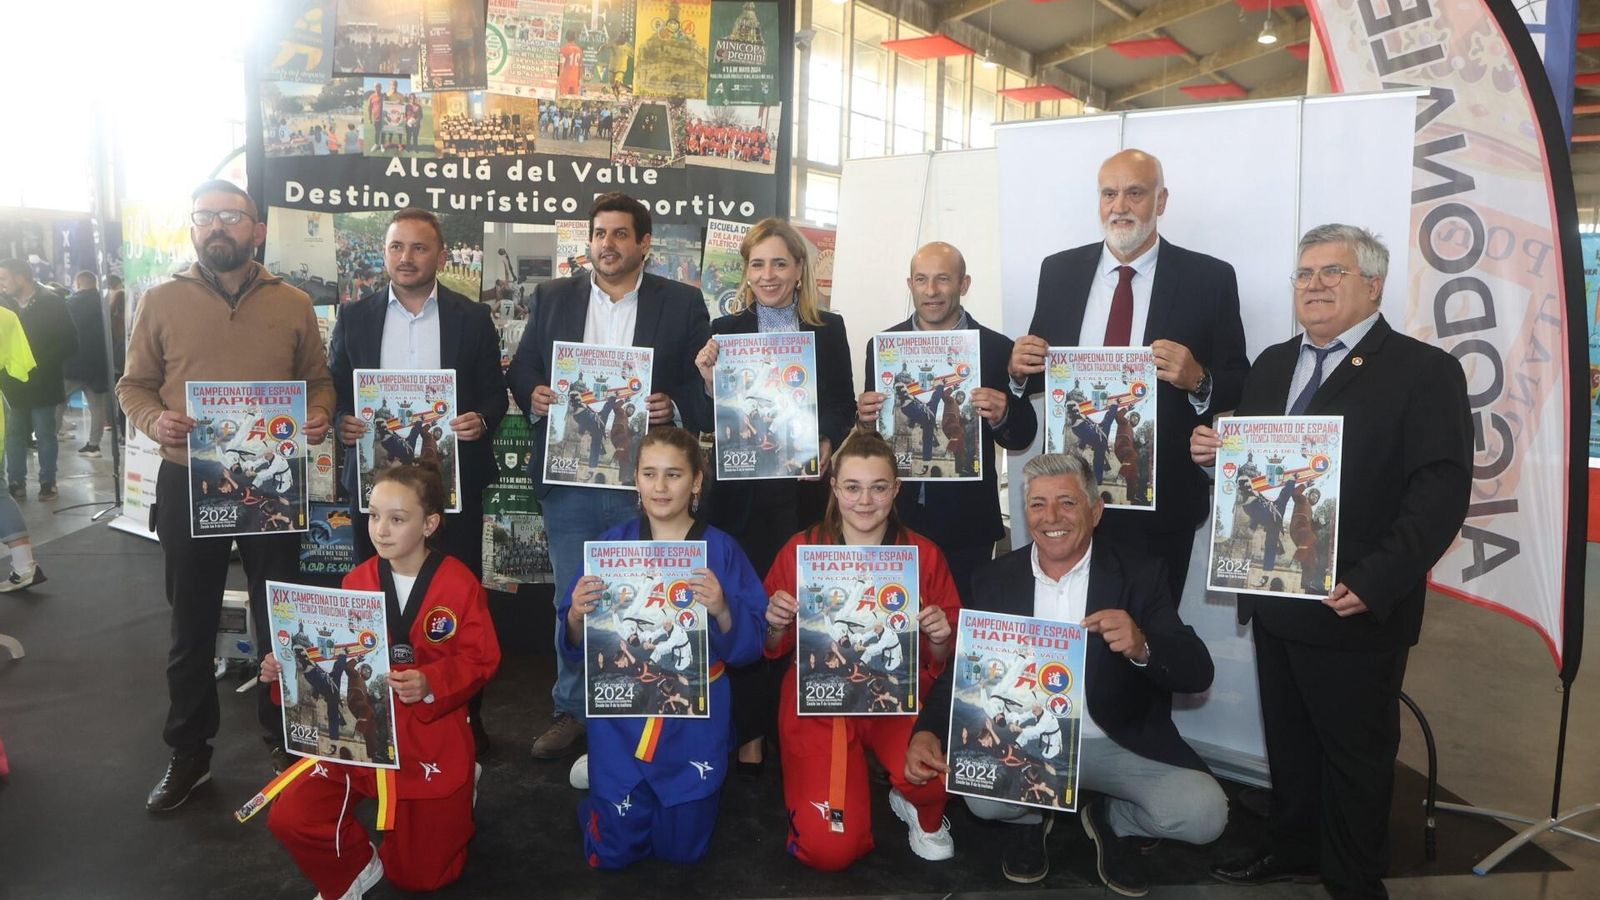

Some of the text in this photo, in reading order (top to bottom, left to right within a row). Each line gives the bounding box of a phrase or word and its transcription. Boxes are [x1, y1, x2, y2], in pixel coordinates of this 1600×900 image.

[716, 40, 765, 56] MINICOPA
[727, 50, 765, 63] premini
[385, 156, 658, 185] Alcalá del Valle
[285, 181, 411, 208] Destino
[426, 187, 577, 214] Turístico
[710, 221, 739, 233] ESCUELA
[720, 338, 768, 348] CAMPEONATO
[770, 337, 780, 346] DE
[880, 337, 951, 349] XIX CAMPEONATO DE
[558, 347, 574, 358] XIX
[575, 348, 616, 360] CAMPEONATO
[617, 351, 625, 360] DE
[726, 346, 802, 356] HAPKIDO
[1050, 352, 1152, 364] XIX CAMPEONATO DE ESPAÑA
[360, 374, 454, 385] XIX CAMPEONATO DE ESPAÑA
[193, 387, 252, 396] CAMPEONATO
[255, 386, 266, 396] DE
[202, 396, 292, 406] HAPKIDO
[1223, 421, 1339, 436] XIX CAMPEONATO DE ESPAÑA
[550, 458, 579, 469] 2024
[724, 454, 757, 466] 2024
[200, 510, 238, 522] 2024
[591, 545, 701, 558] CAMPEONATO DE ESPAÑA
[804, 550, 913, 560] CAMPEONATO DE ESPAÑA
[600, 558, 691, 568] HAPKIDO
[812, 562, 903, 571] HAPKIDO
[1218, 560, 1250, 573] 2024
[272, 589, 381, 610] XIX CAMPEONATO DE ESPAÑA
[966, 616, 1082, 640] CAMPEONATO DE ESPAÑA
[973, 629, 1069, 650] HAPKIDO
[1047, 672, 1062, 686] 道
[595, 686, 635, 700] 2024
[806, 686, 845, 698] 2024
[291, 724, 319, 741] 2024
[955, 763, 997, 781] 2024
